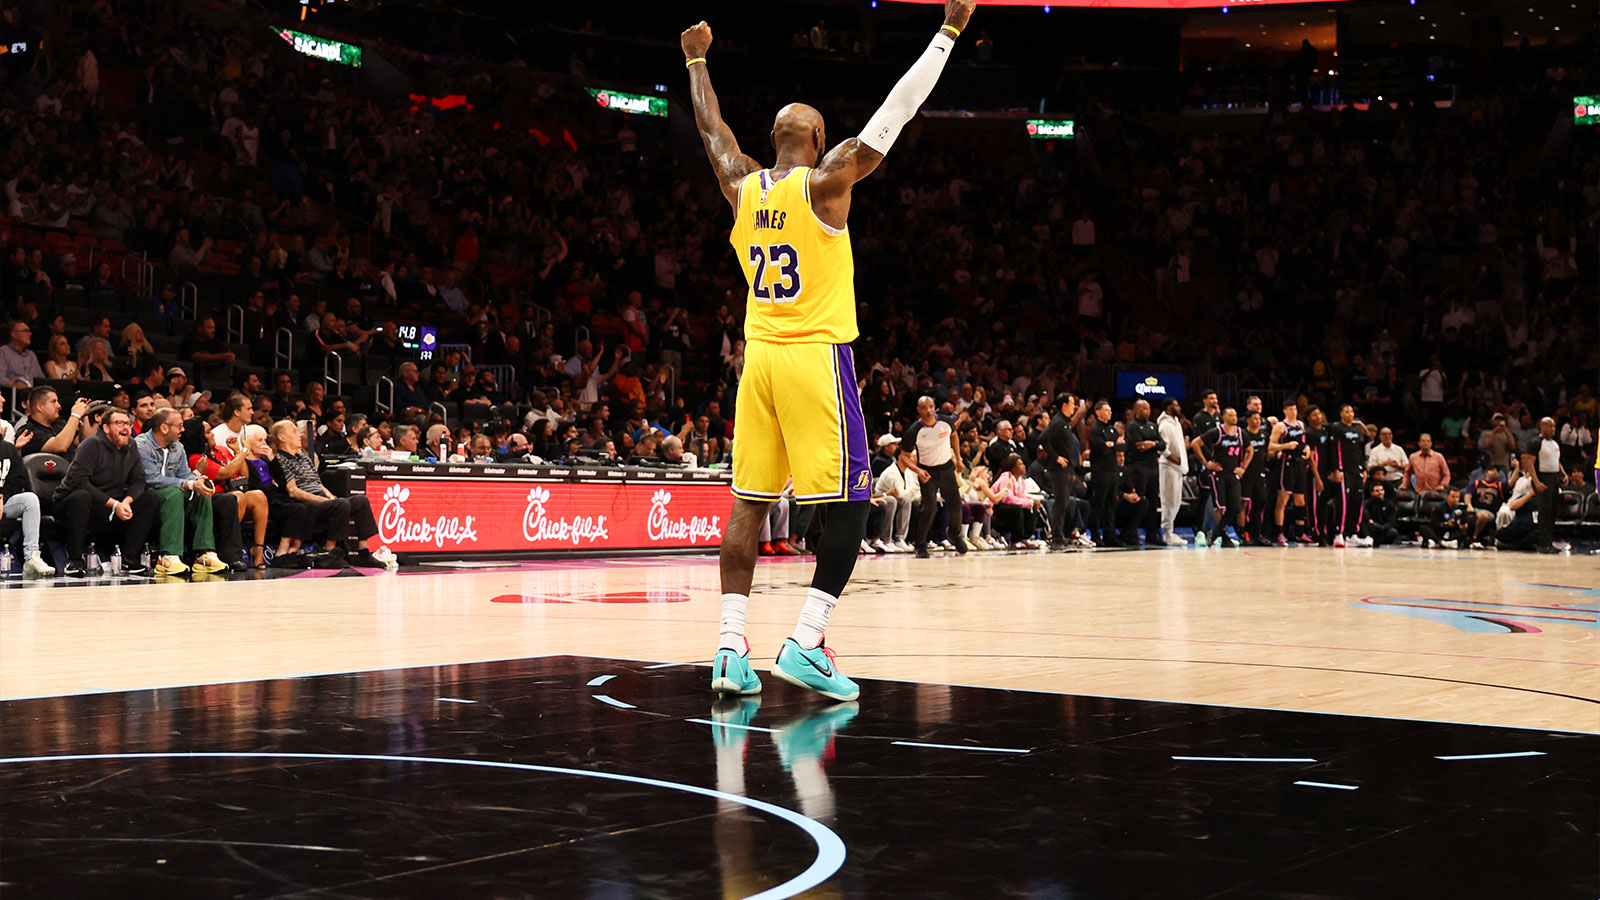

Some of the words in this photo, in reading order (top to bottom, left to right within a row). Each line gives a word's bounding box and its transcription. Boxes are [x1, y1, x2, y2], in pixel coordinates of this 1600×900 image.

[752, 209, 786, 231] AMES
[748, 242, 802, 304] 23
[398, 325, 416, 339] 14.8
[378, 493, 478, 547] Chick-fil-A
[522, 493, 608, 545] Chick-fil-A
[647, 494, 722, 544] Chick-fil-A
